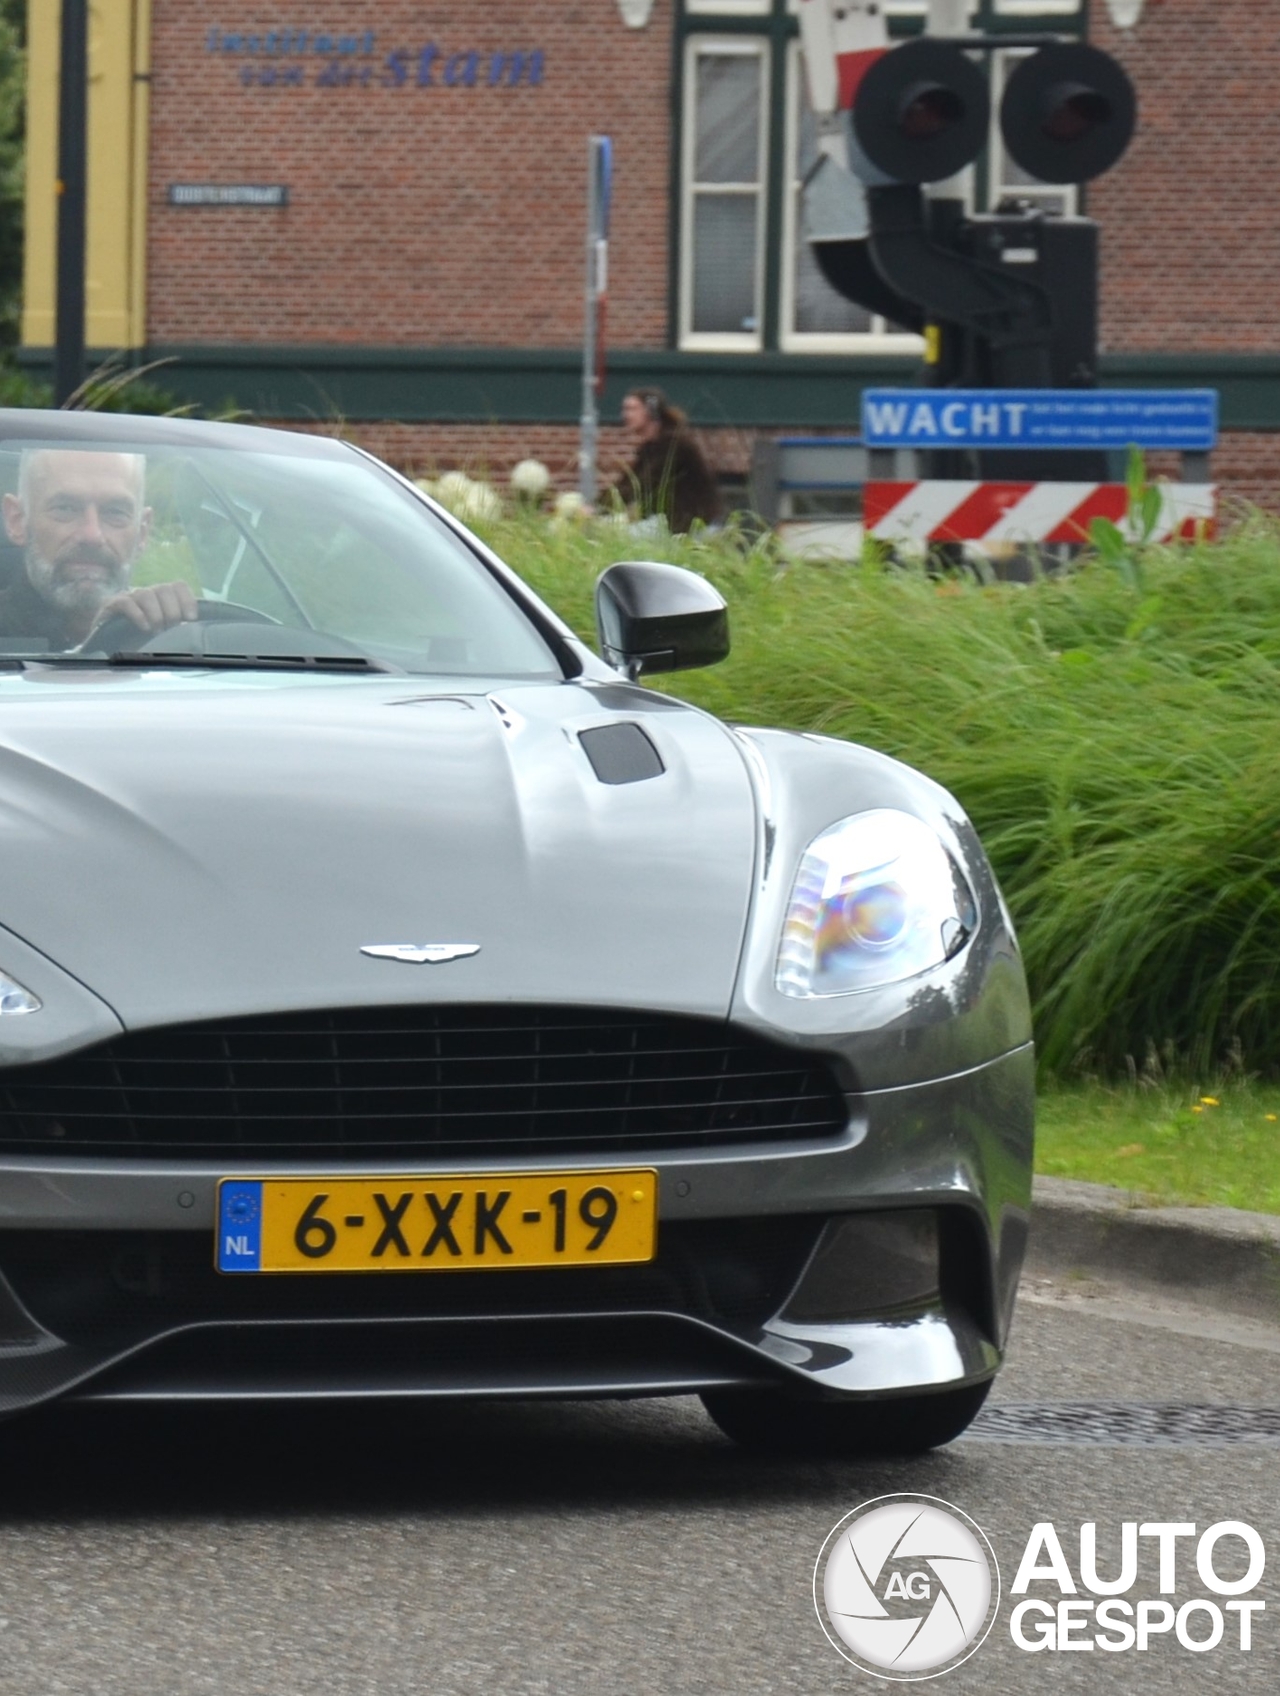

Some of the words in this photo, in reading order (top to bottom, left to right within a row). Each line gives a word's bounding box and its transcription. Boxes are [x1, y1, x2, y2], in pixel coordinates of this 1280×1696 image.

[868, 402, 1028, 437] WACHT
[225, 1235, 255, 1256] NL
[294, 1185, 618, 1259] 6-XXK-19
